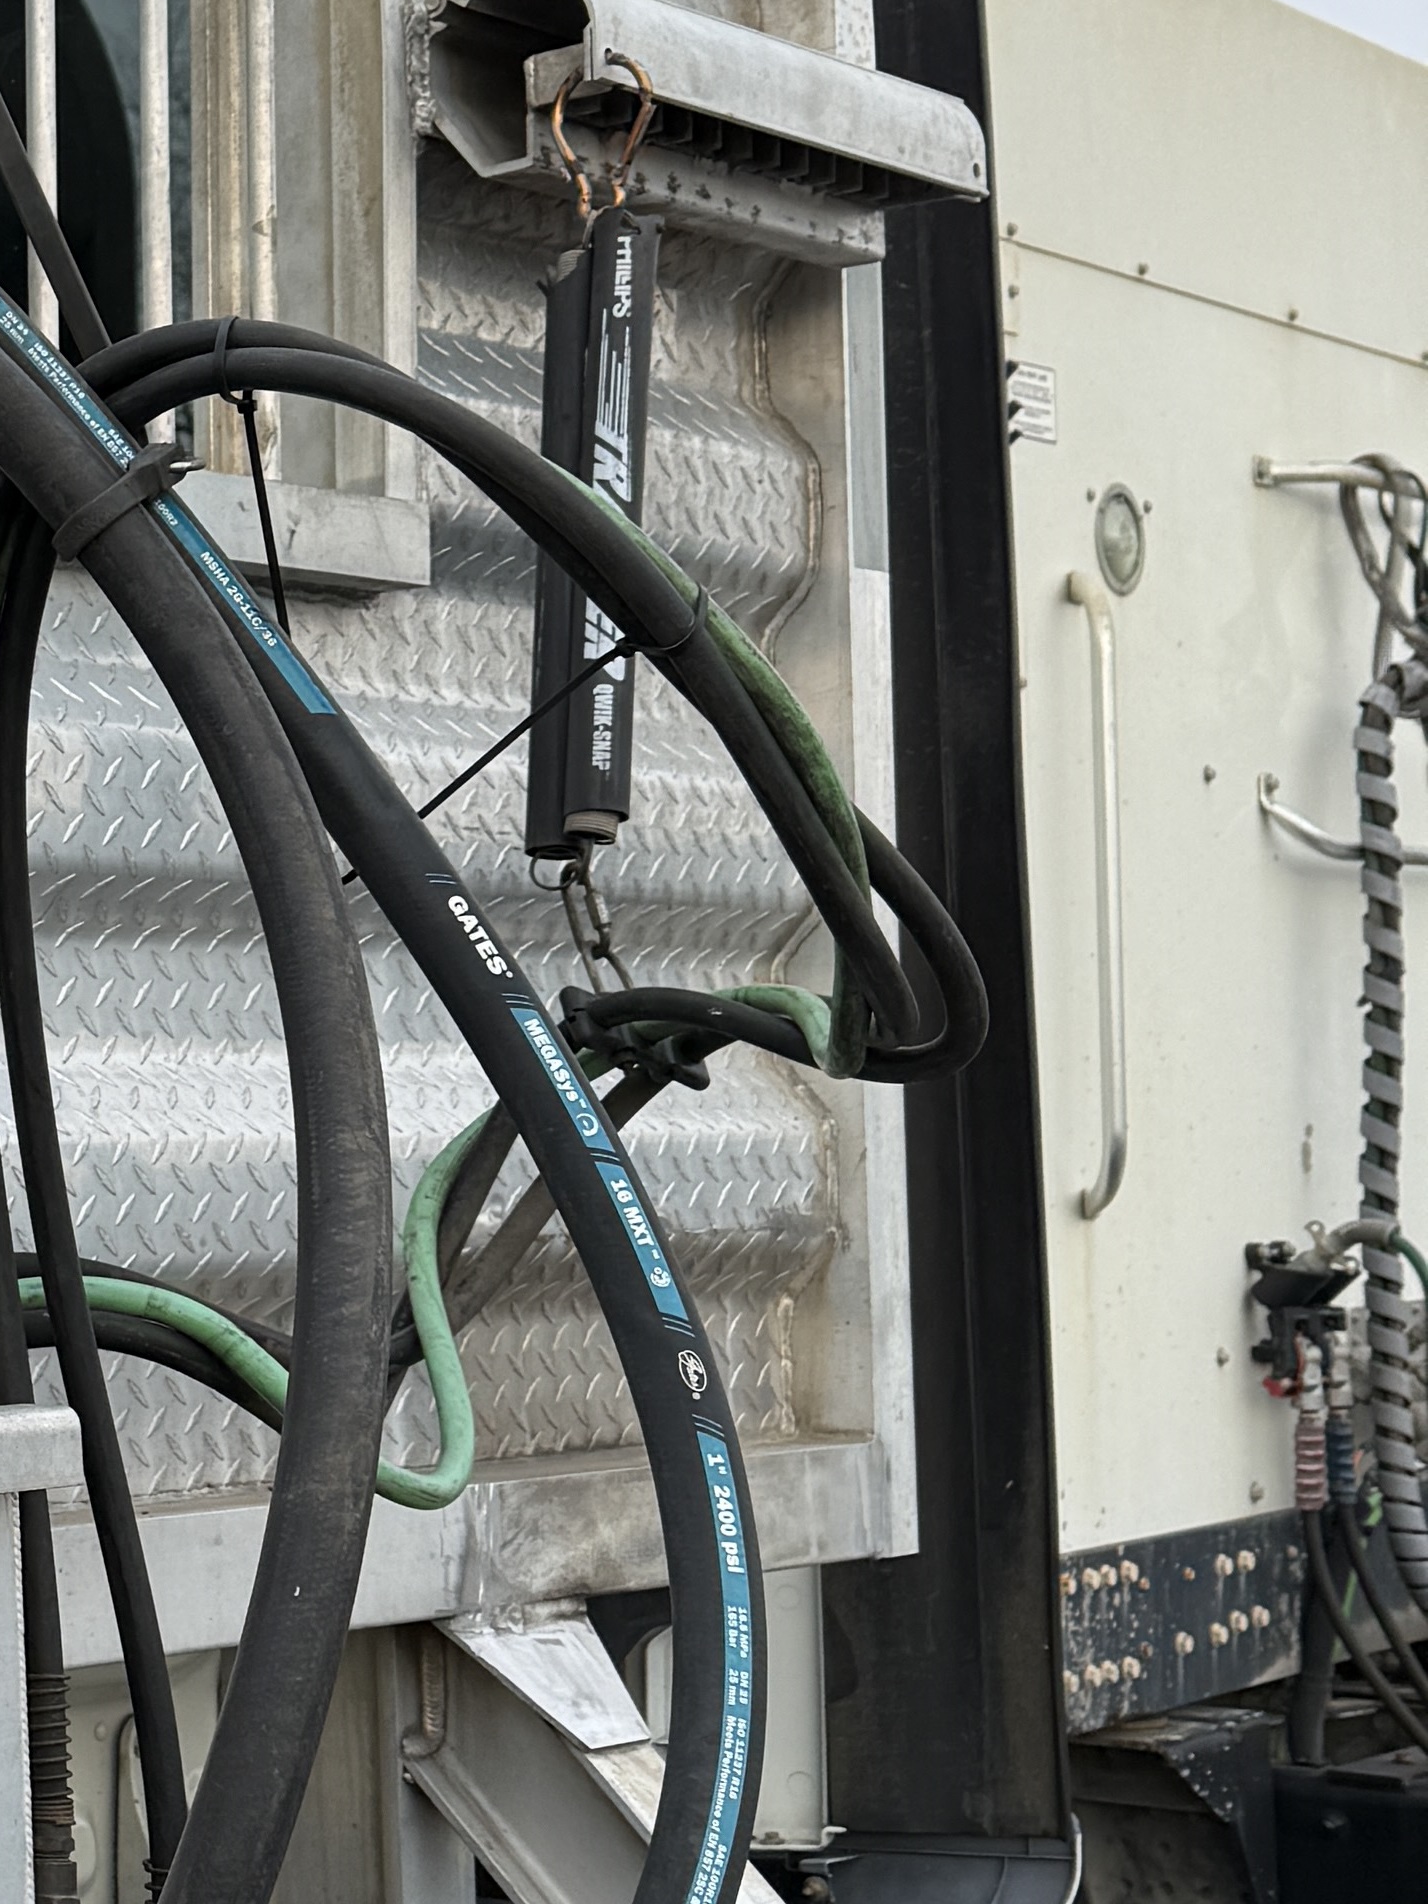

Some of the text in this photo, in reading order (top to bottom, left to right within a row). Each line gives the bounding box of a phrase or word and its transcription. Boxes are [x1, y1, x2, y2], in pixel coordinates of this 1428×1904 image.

[200, 551, 230, 586] MSHA
[226, 585, 278, 647] 2G-11C/36
[610, 1179, 633, 1203] 16
[713, 1485, 737, 1537] 2400
[721, 1541, 746, 1575] psi
[728, 1668, 739, 1685] 25
[714, 1844, 728, 1867] SAE
